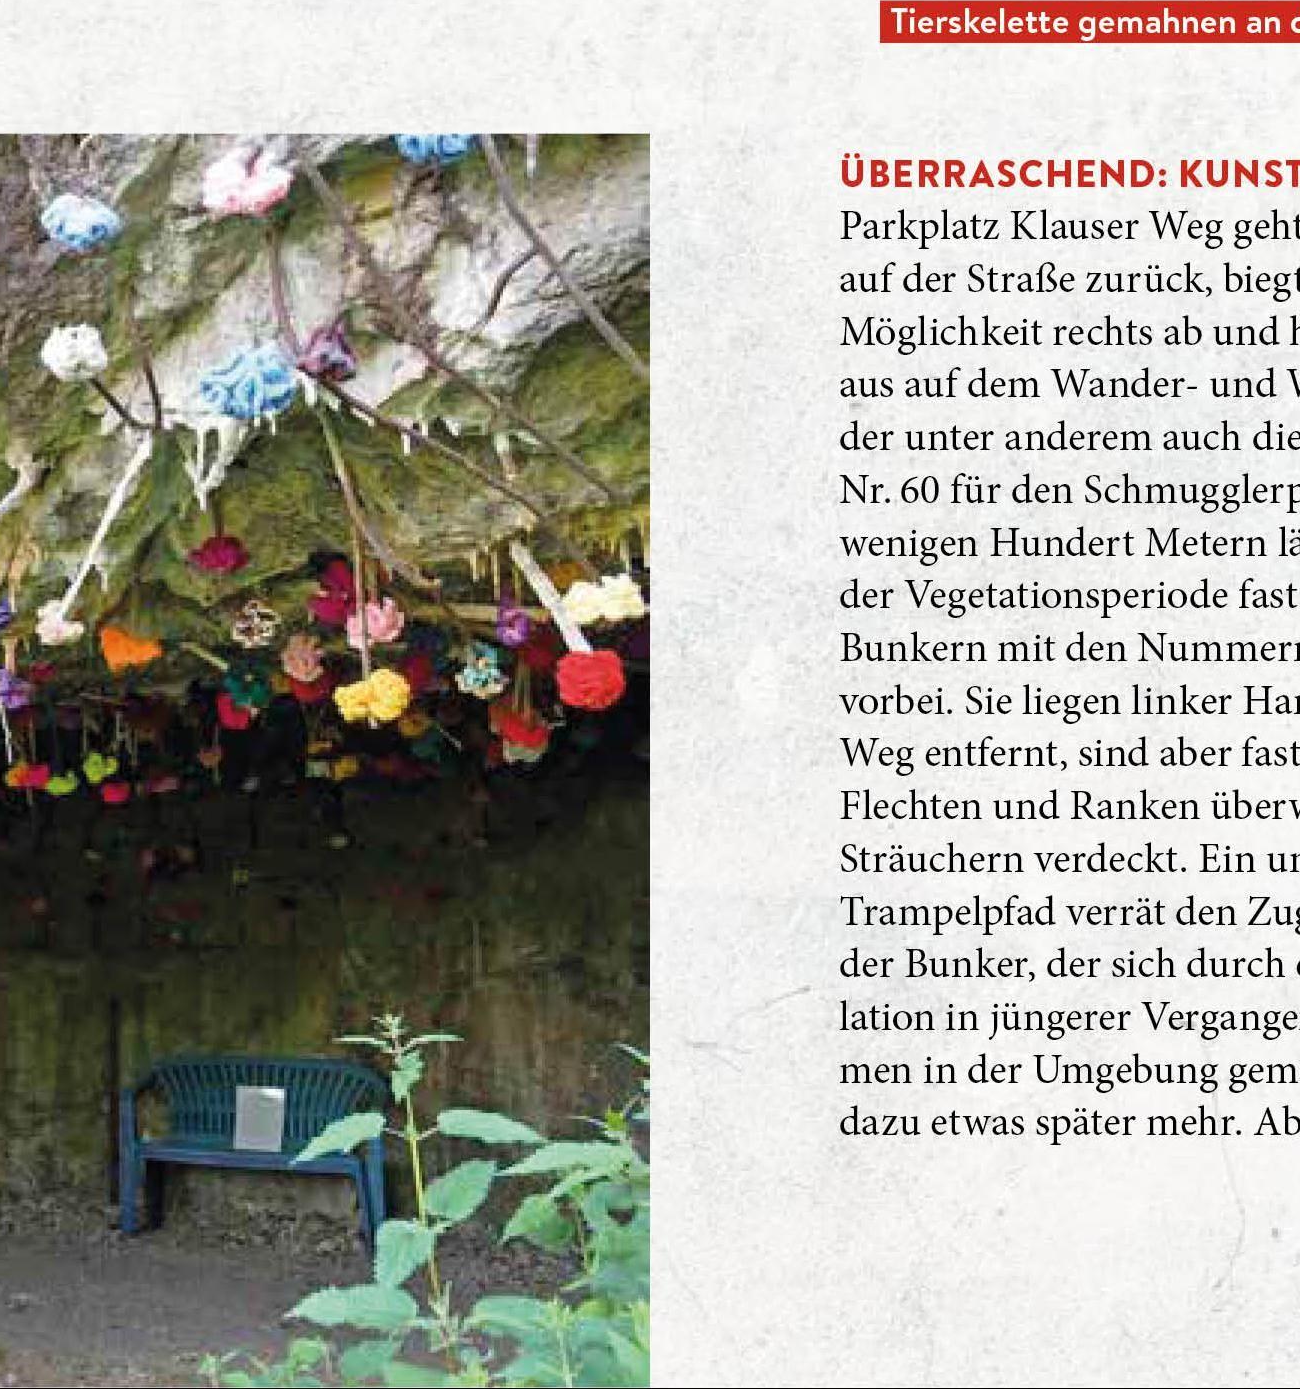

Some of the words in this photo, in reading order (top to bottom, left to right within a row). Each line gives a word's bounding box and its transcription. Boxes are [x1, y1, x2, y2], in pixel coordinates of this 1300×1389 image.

[891, 8, 1068, 33] Tierskelette
[1079, 8, 1235, 41] gemahnen
[1247, 17, 1280, 33] an
[842, 153, 1166, 187] ÜBERRASCHEND:
[840, 420, 894, 450] der
[905, 425, 994, 450] unter
[1006, 420, 1152, 450] anderem
[1164, 420, 1241, 450] auch
[841, 631, 987, 661] Bunkern
[998, 635, 1055, 661] mit
[1066, 631, 1127, 661] den
[840, 948, 894, 977] der
[905, 947, 1035, 982] Bunker,
[1047, 947, 1101, 977] der
[1112, 947, 1176, 977] sich
[1187, 947, 1285, 977] durch
